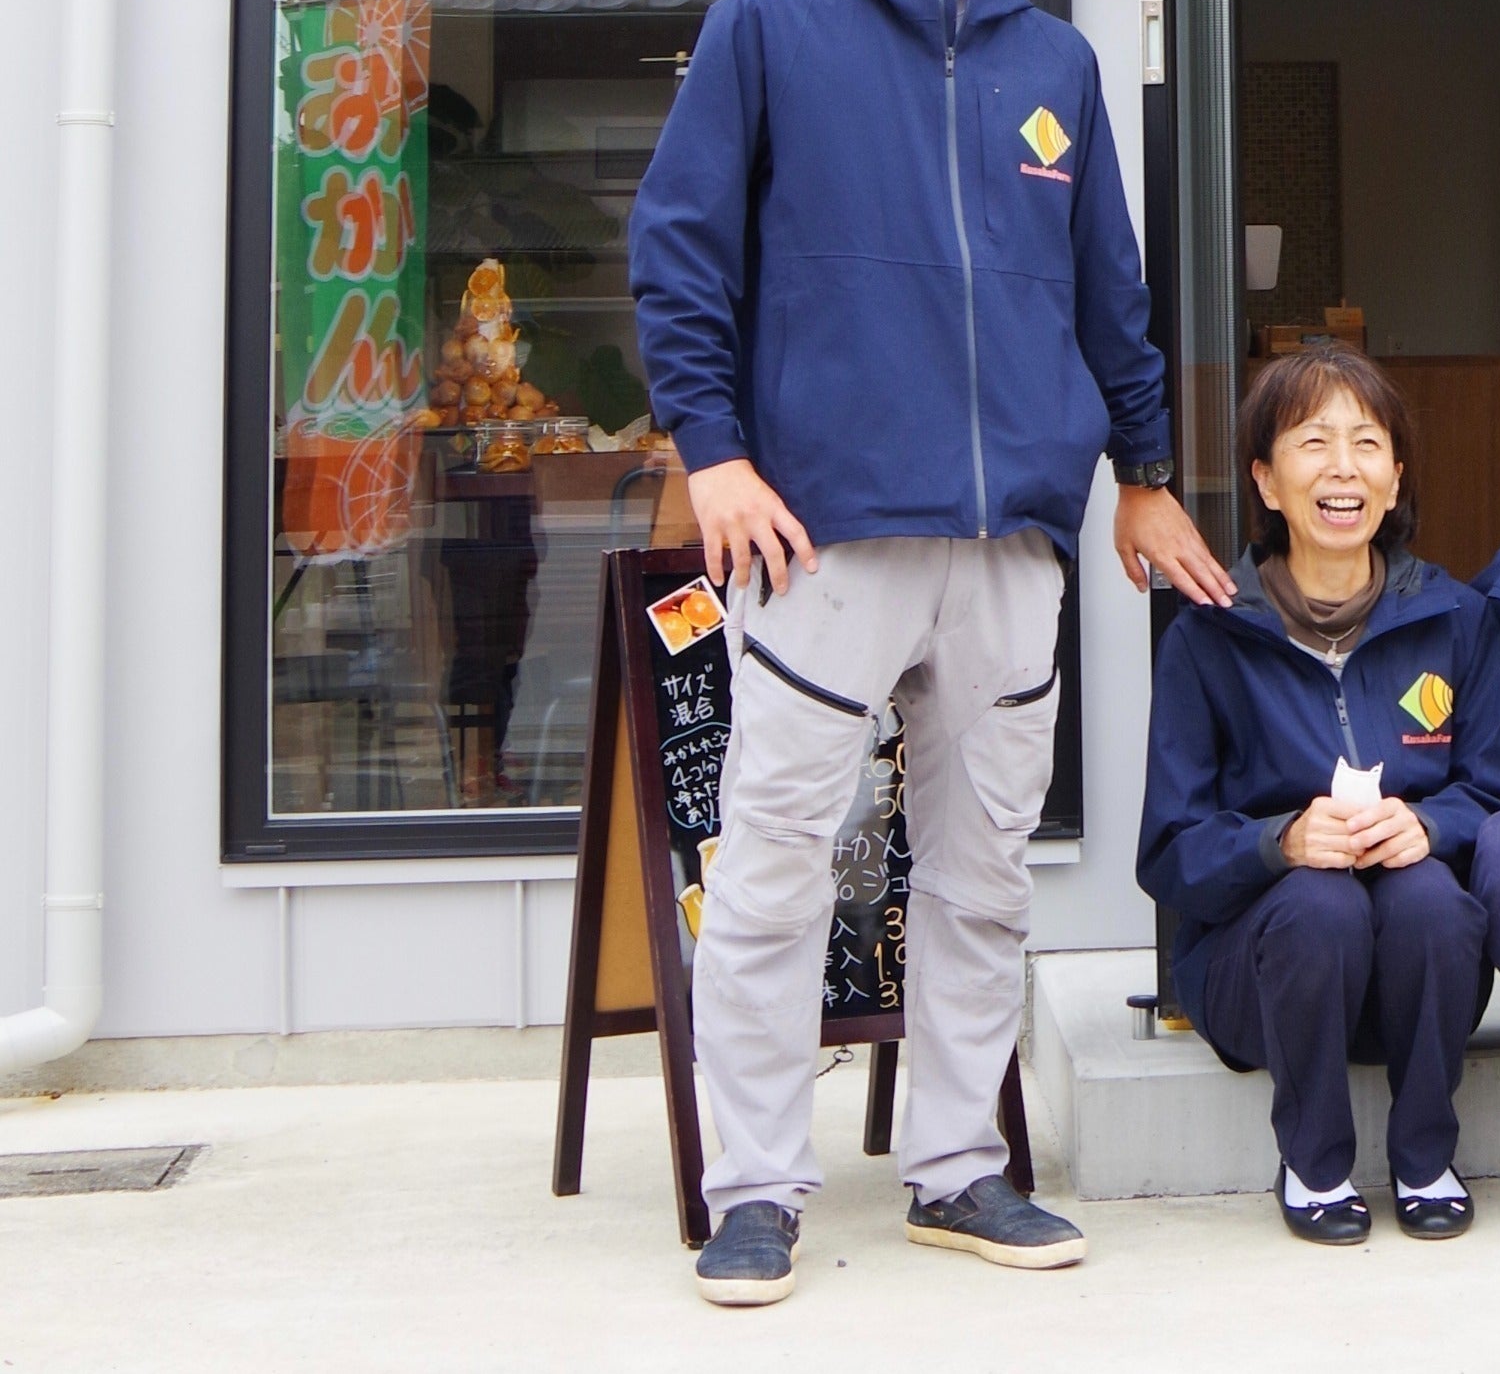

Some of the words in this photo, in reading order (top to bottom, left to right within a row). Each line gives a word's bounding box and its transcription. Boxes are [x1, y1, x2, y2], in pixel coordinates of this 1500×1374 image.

[661, 662, 715, 701] サイズ
[669, 695, 715, 727] 混合
